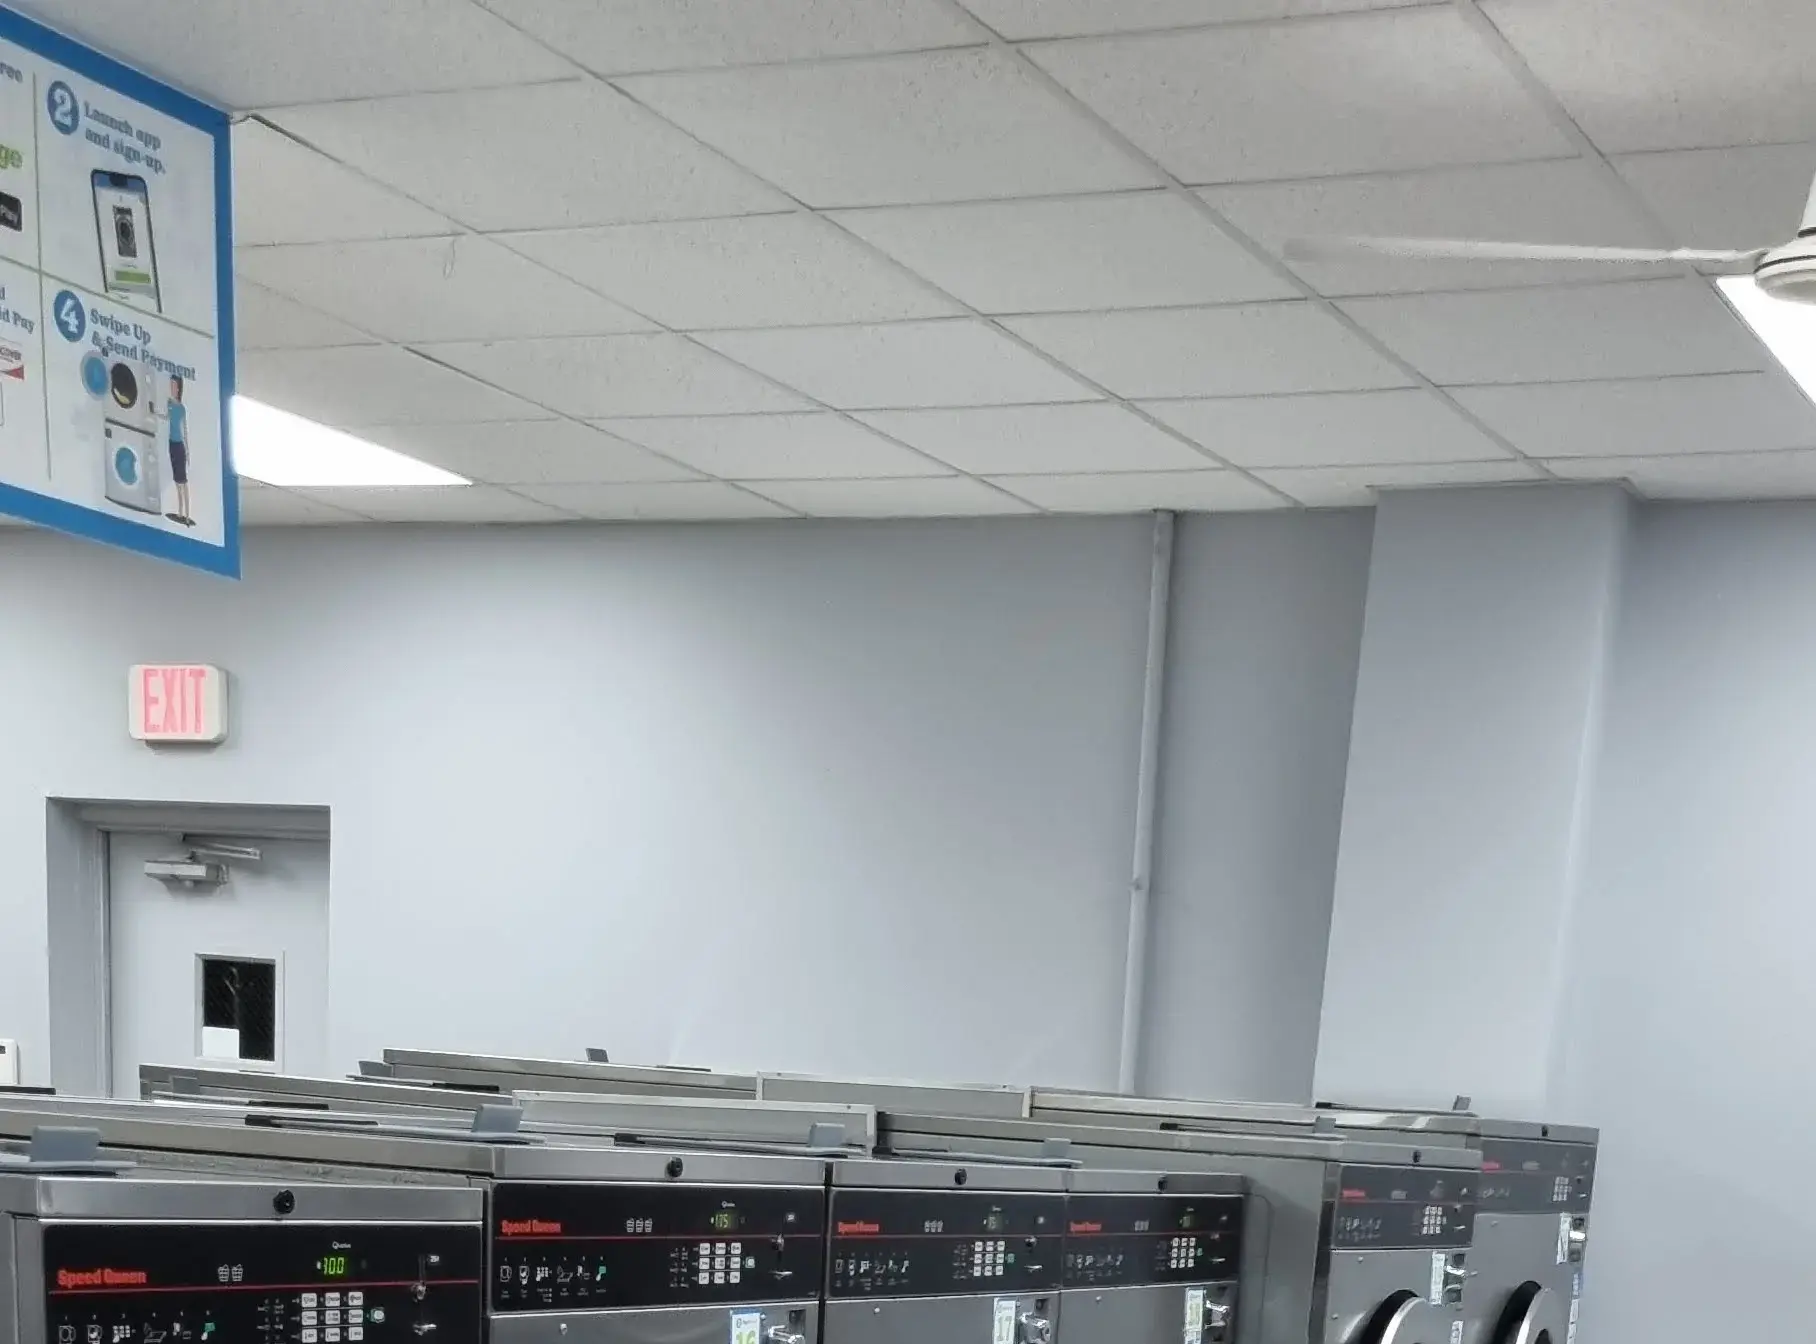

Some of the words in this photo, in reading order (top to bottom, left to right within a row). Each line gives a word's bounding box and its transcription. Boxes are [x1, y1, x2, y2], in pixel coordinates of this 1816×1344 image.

[54, 88, 72, 126] 2
[84, 101, 133, 137] Launch
[136, 129, 161, 150] app
[85, 127, 110, 149] and
[13, 311, 35, 334] Pay
[60, 299, 78, 333] 4
[90, 308, 130, 335] Swipe
[133, 323, 151, 346] Up
[92, 331, 102, 347] &
[106, 335, 138, 360] Send
[141, 349, 196, 381] Payment
[144, 668, 206, 733] EXIT
[58, 1268, 101, 1289] Speed
[103, 1268, 146, 1284] Queen
[997, 1316, 1012, 1341] 17
